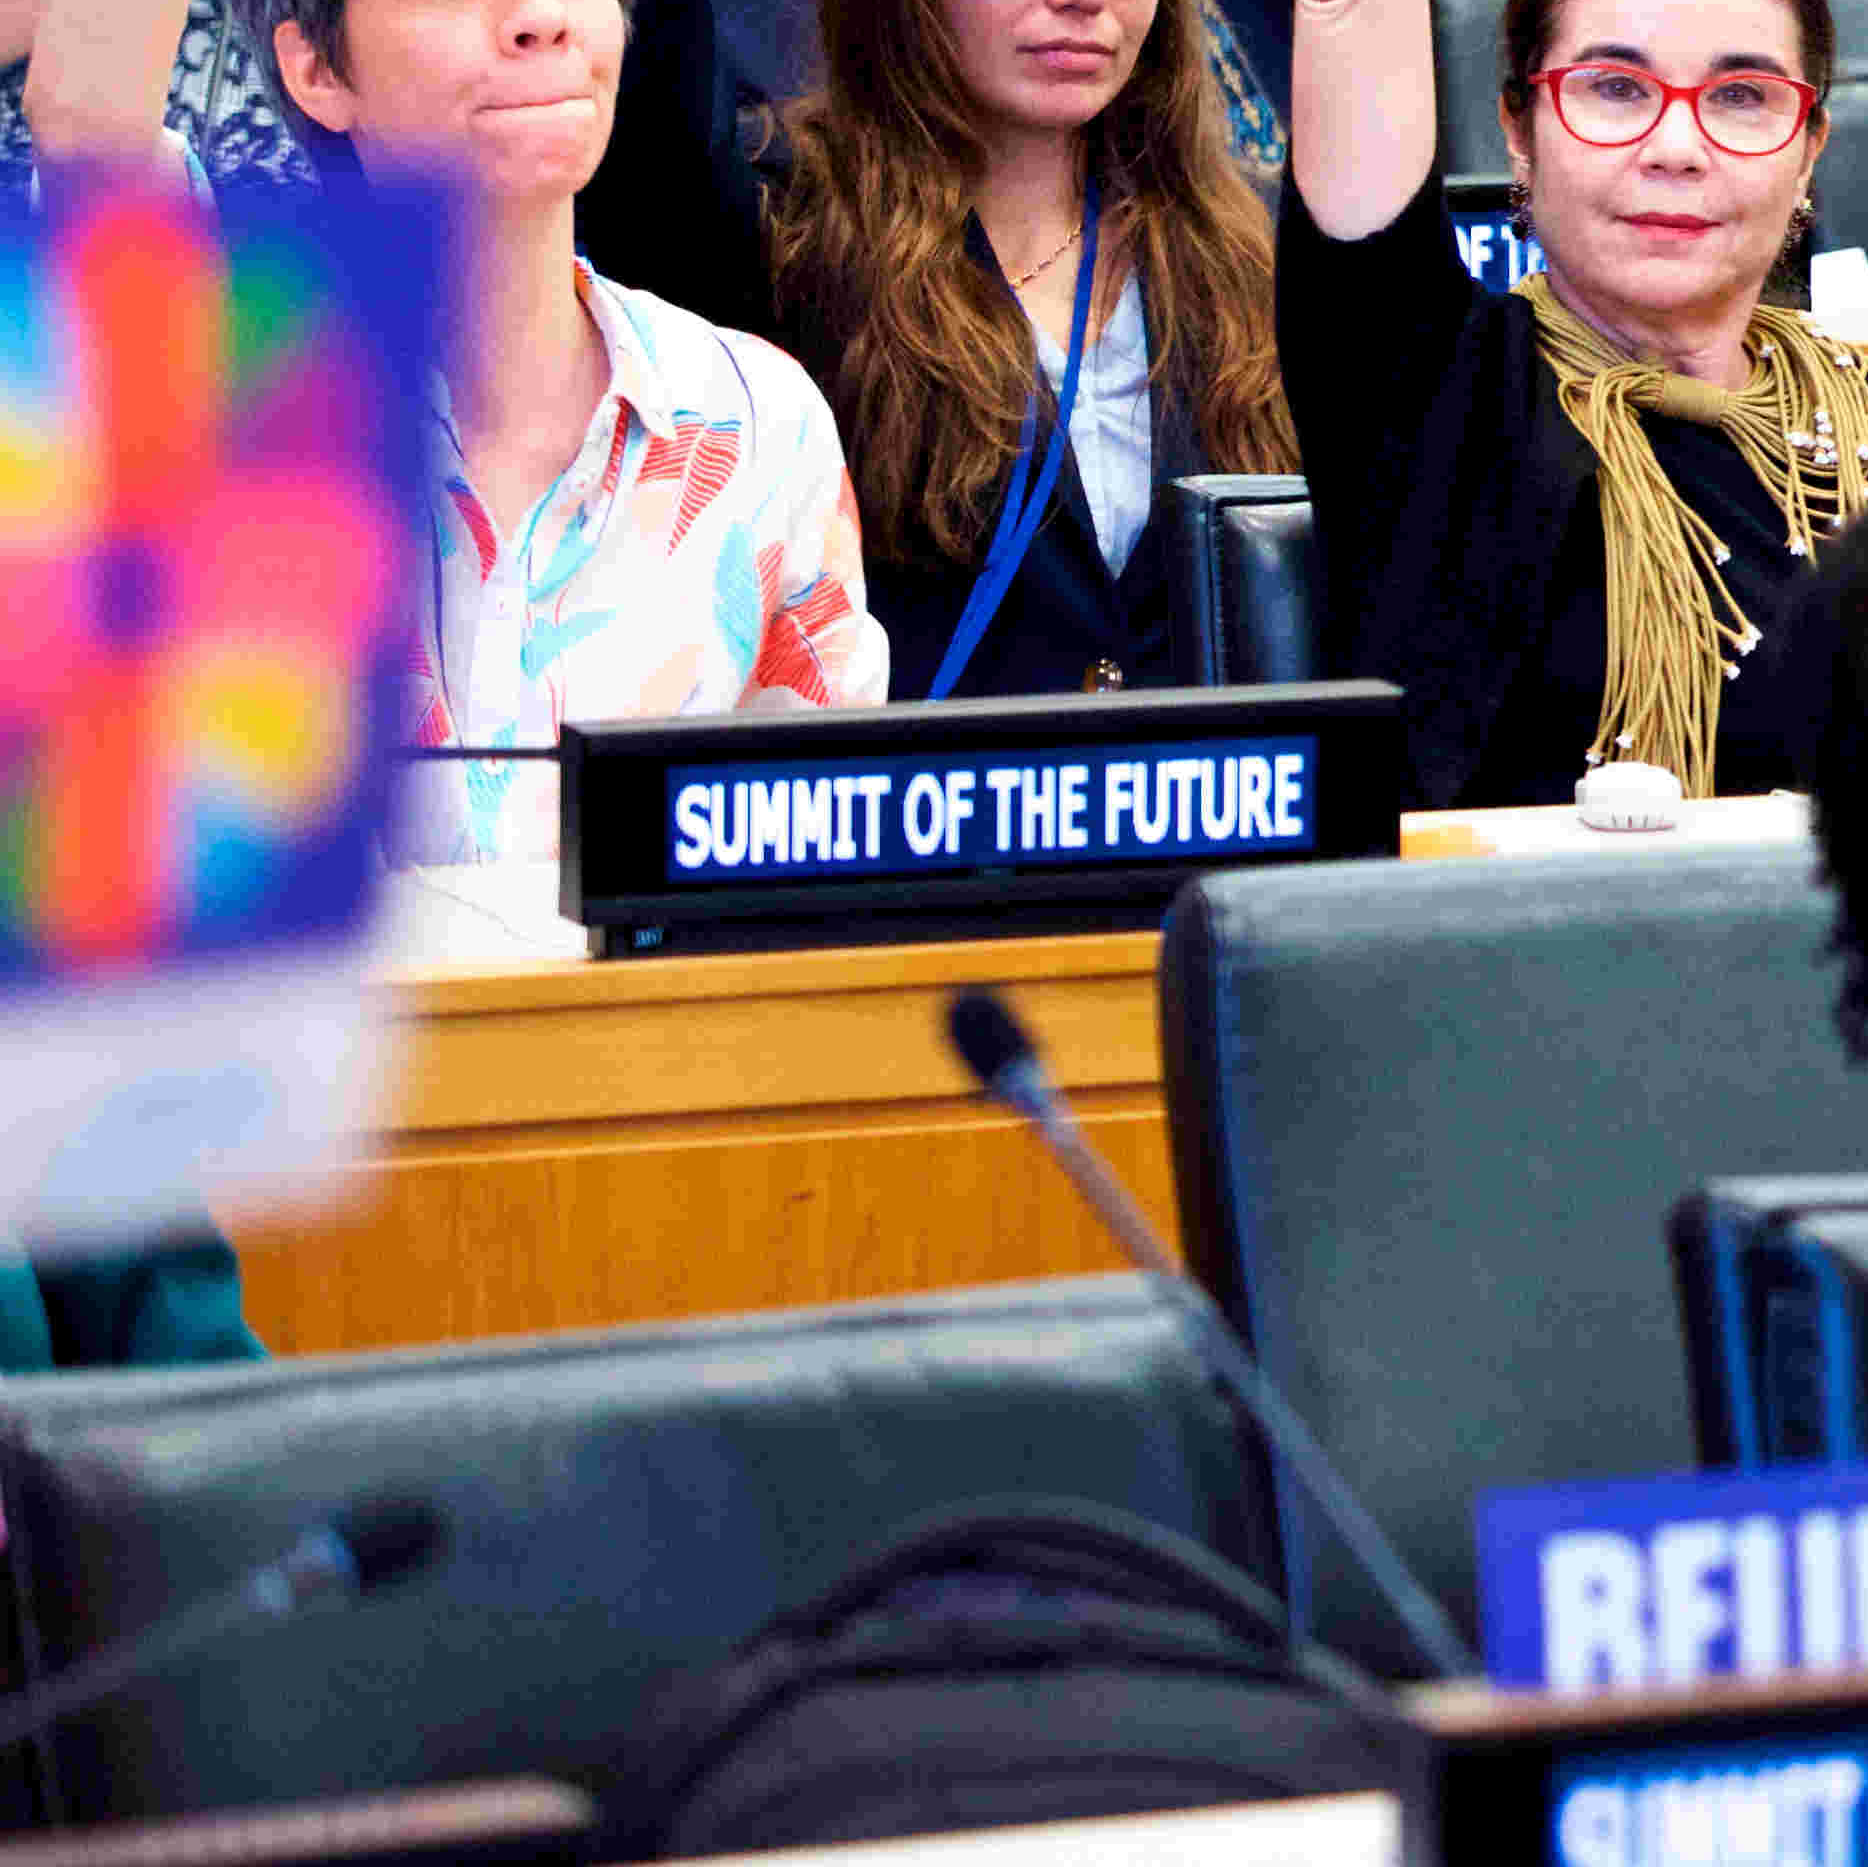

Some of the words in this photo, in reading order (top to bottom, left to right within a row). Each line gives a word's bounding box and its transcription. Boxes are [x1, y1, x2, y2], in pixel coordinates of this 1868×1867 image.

[673, 774, 890, 870] SUMMIT
[903, 770, 974, 860] OF
[996, 763, 1090, 851] THE
[1104, 753, 1304, 848] FUTURE
